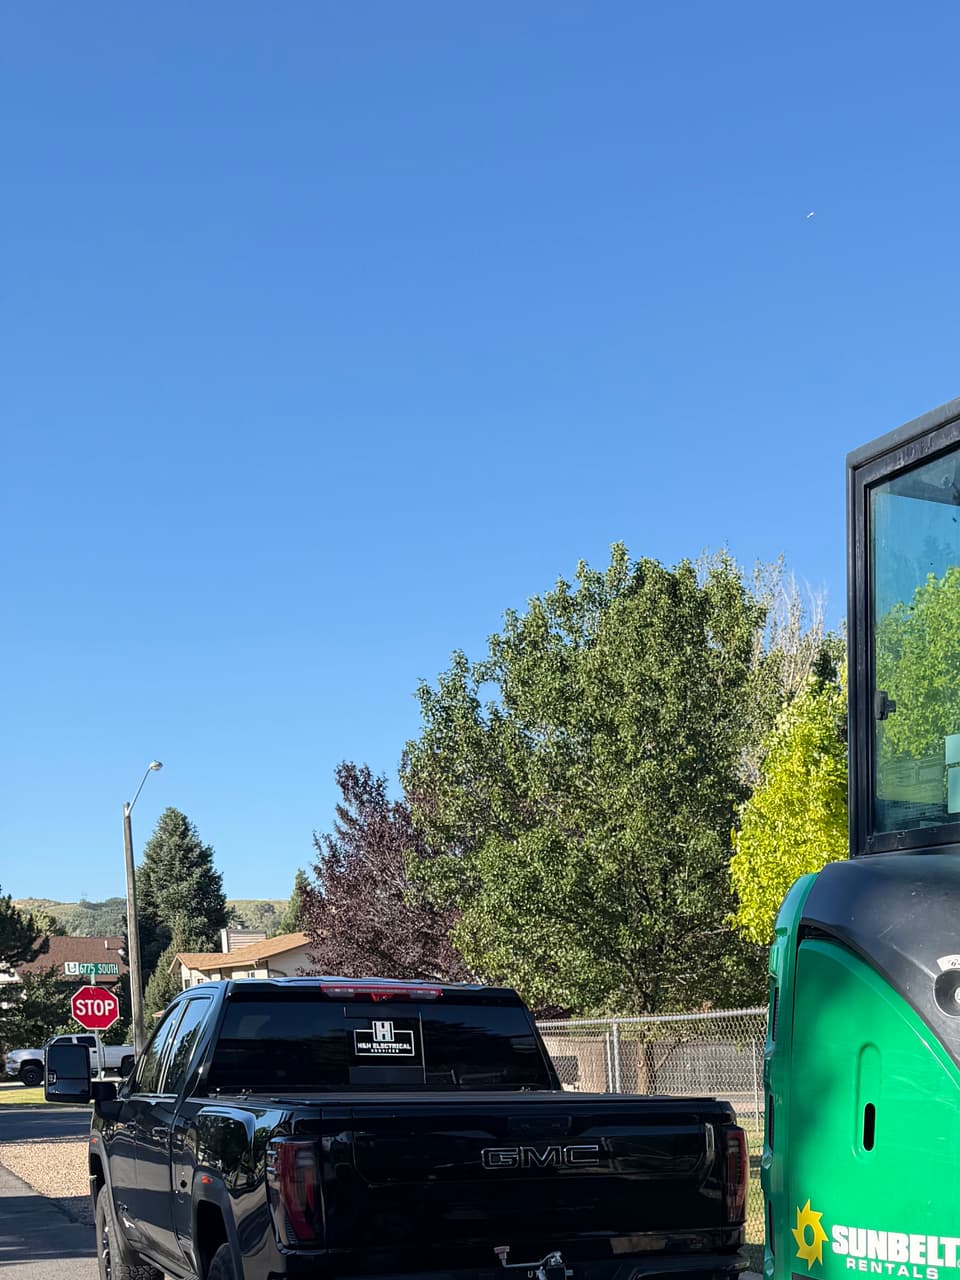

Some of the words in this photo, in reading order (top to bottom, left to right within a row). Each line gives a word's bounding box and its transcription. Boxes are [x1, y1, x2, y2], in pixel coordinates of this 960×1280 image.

[79, 963, 96, 974] 6775
[97, 963, 119, 974] SOUTH
[76, 999, 115, 1016] STOP
[372, 1042, 411, 1050] ELECTRICAL
[480, 1144, 600, 1170] GMC
[846, 1257, 939, 1280] RENTALS
